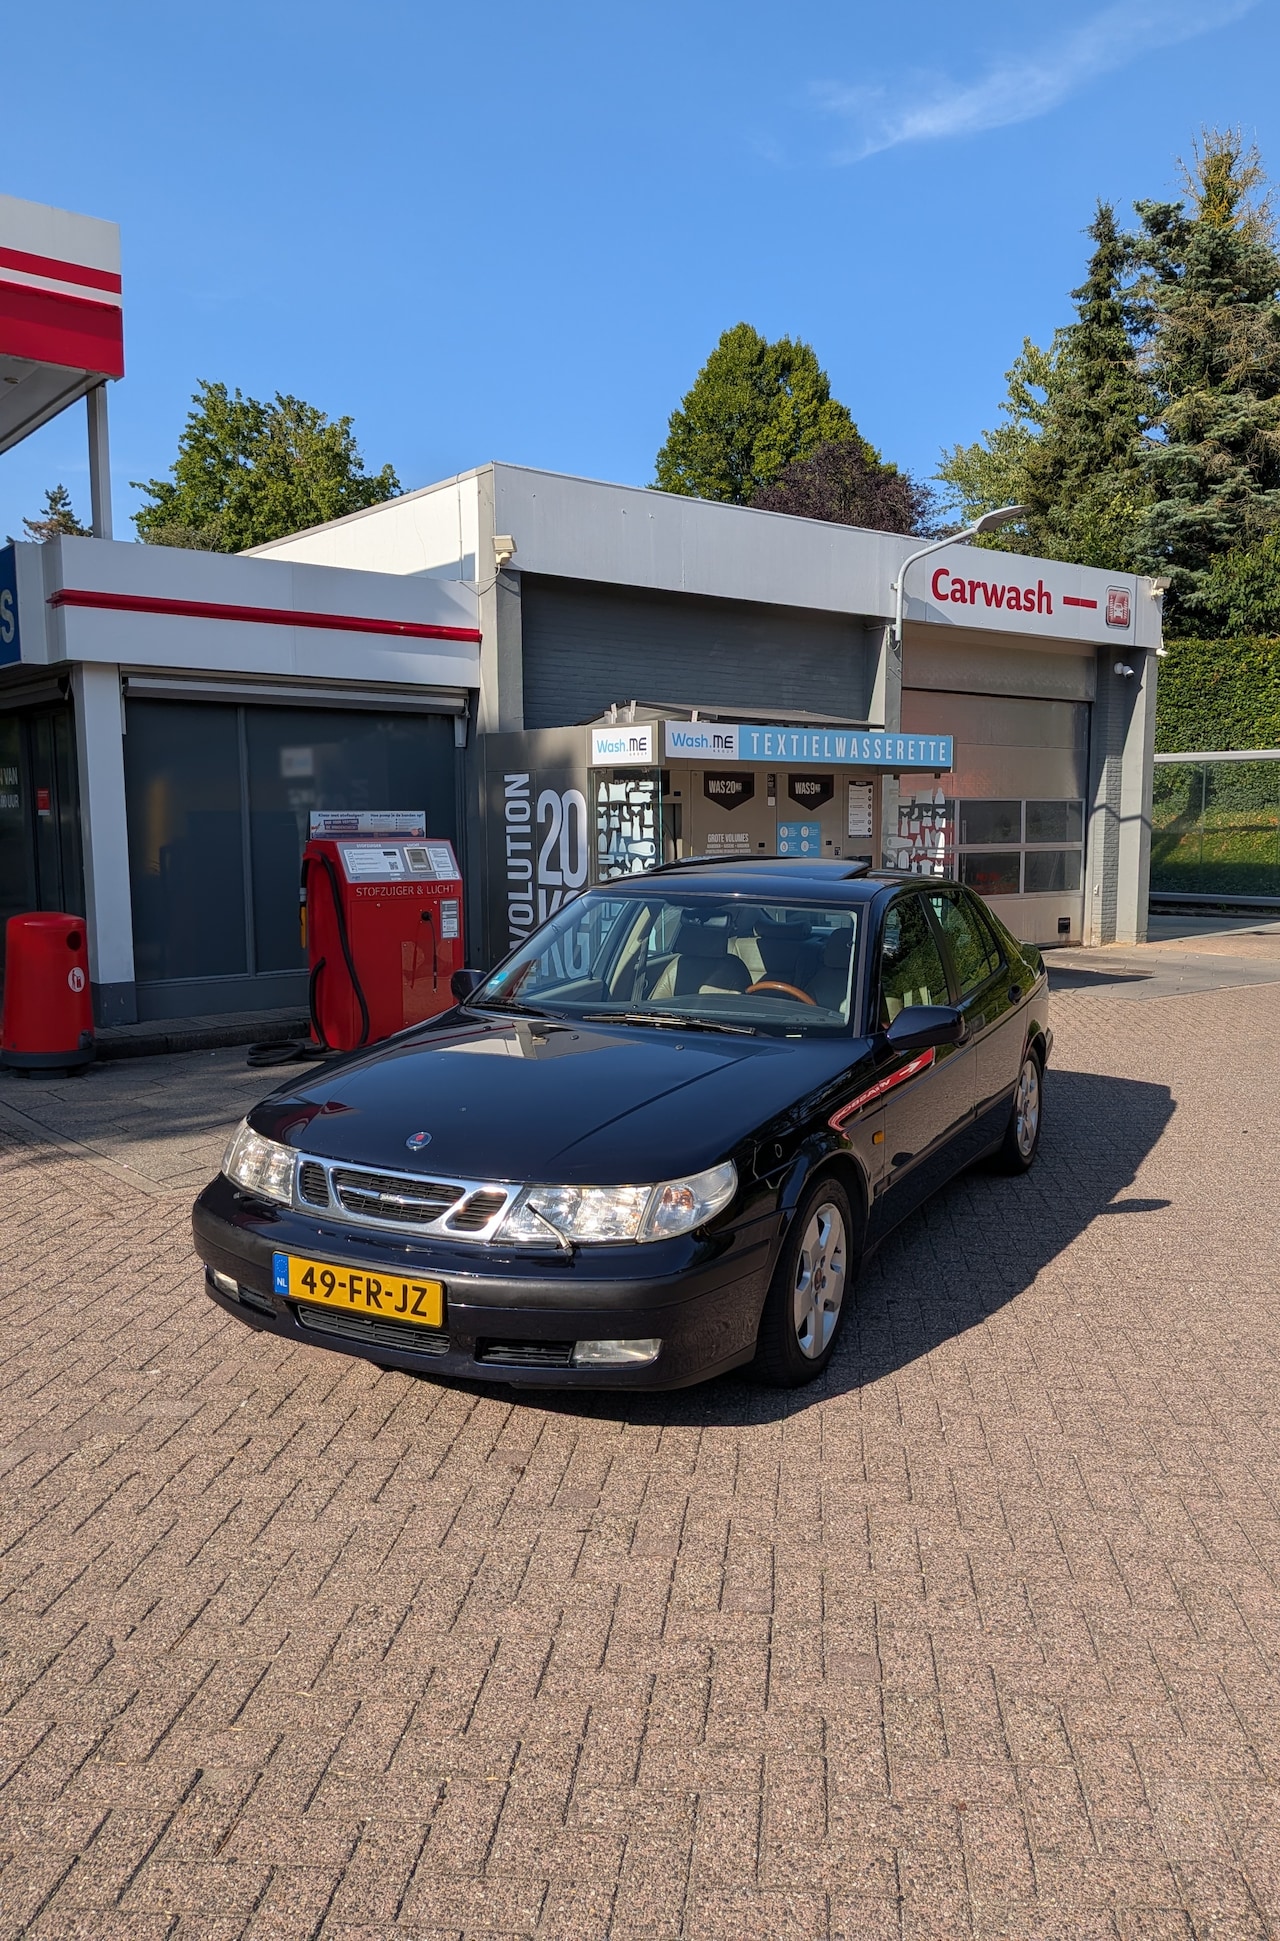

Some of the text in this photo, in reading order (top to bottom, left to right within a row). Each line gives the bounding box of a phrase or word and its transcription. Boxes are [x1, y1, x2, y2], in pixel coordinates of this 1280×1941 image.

[931, 568, 1053, 615] Carwash
[751, 732, 947, 762] TEXTIELWASSERETTE
[536, 789, 588, 888] 20
[356, 887, 414, 897] STOFZUIGER
[426, 885, 454, 895] LUCHT
[277, 1277, 287, 1288] NL
[301, 1266, 428, 1317] 49-FR-JZ
